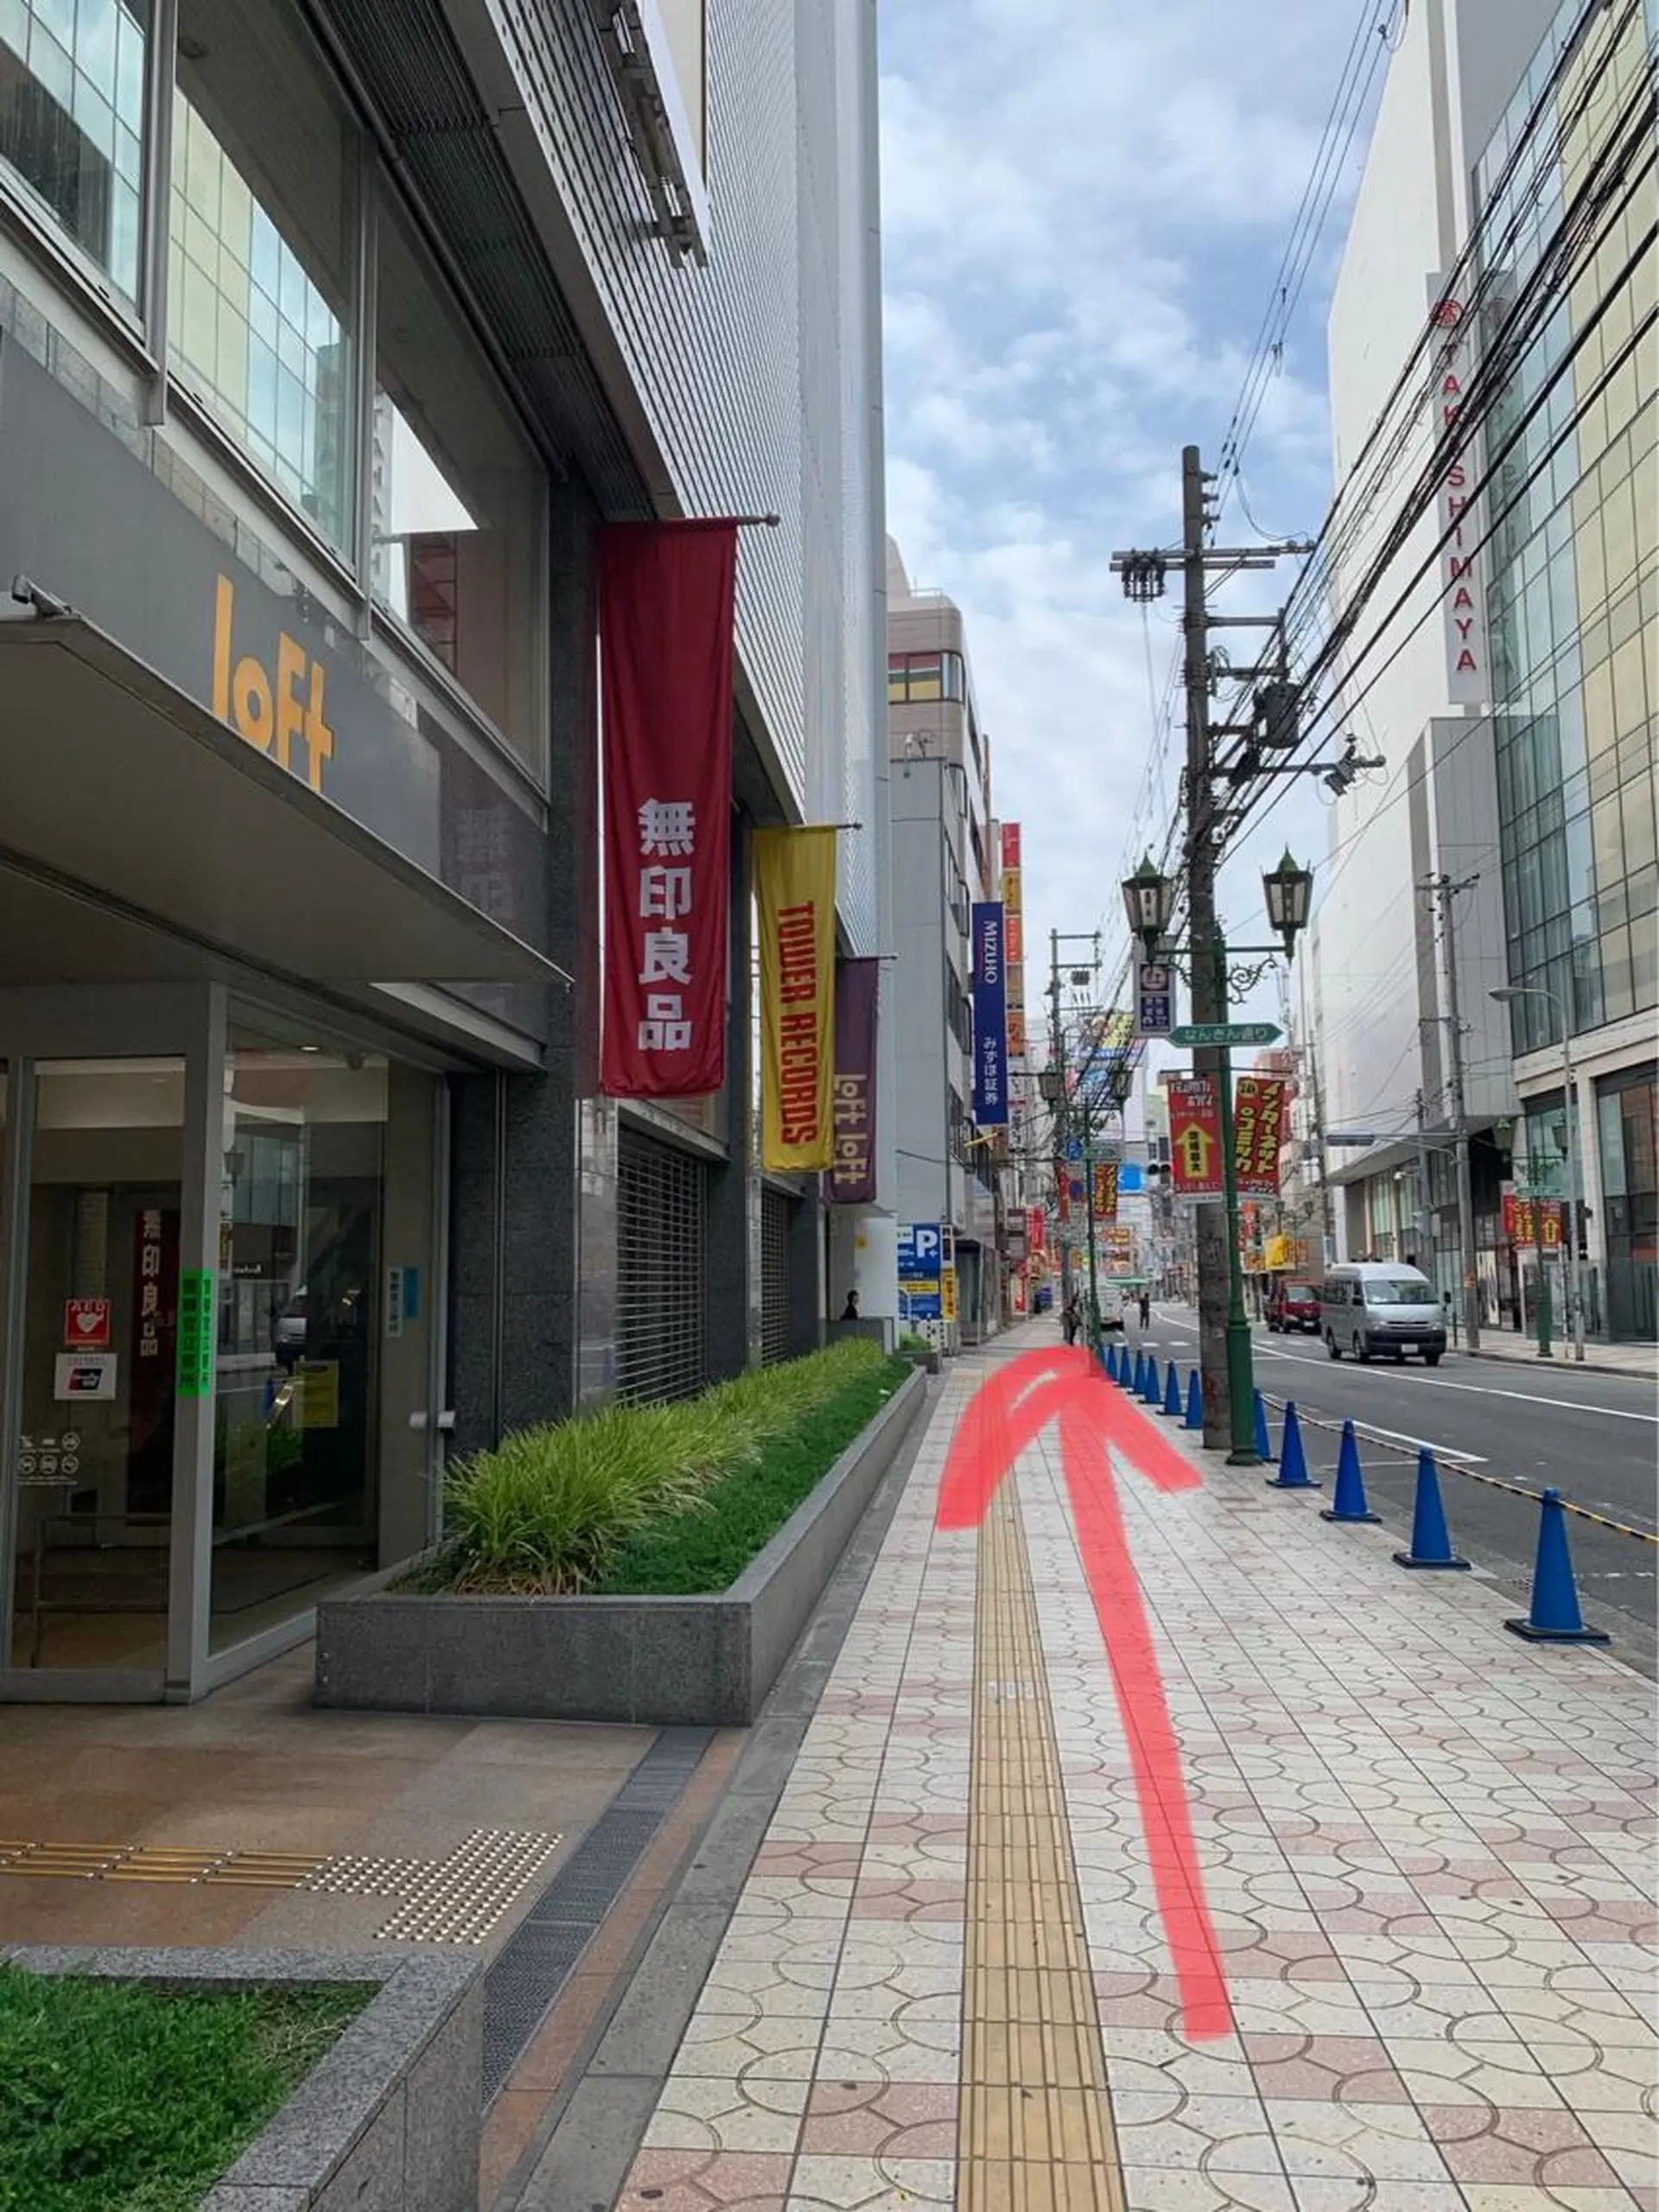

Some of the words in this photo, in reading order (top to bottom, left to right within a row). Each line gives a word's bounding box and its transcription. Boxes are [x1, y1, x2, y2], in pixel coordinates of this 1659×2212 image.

[1441, 343, 1477, 671] TAKSHIMAYA
[638, 798, 696, 1051] 無印良品
[778, 900, 816, 1005] TOWER
[983, 919, 998, 985] MIZUHO
[779, 1010, 818, 1146] RECORDS
[982, 1037, 999, 1106] みずほ証券
[1255, 1081, 1281, 1174] インターネット
[916, 1230, 938, 1258] P
